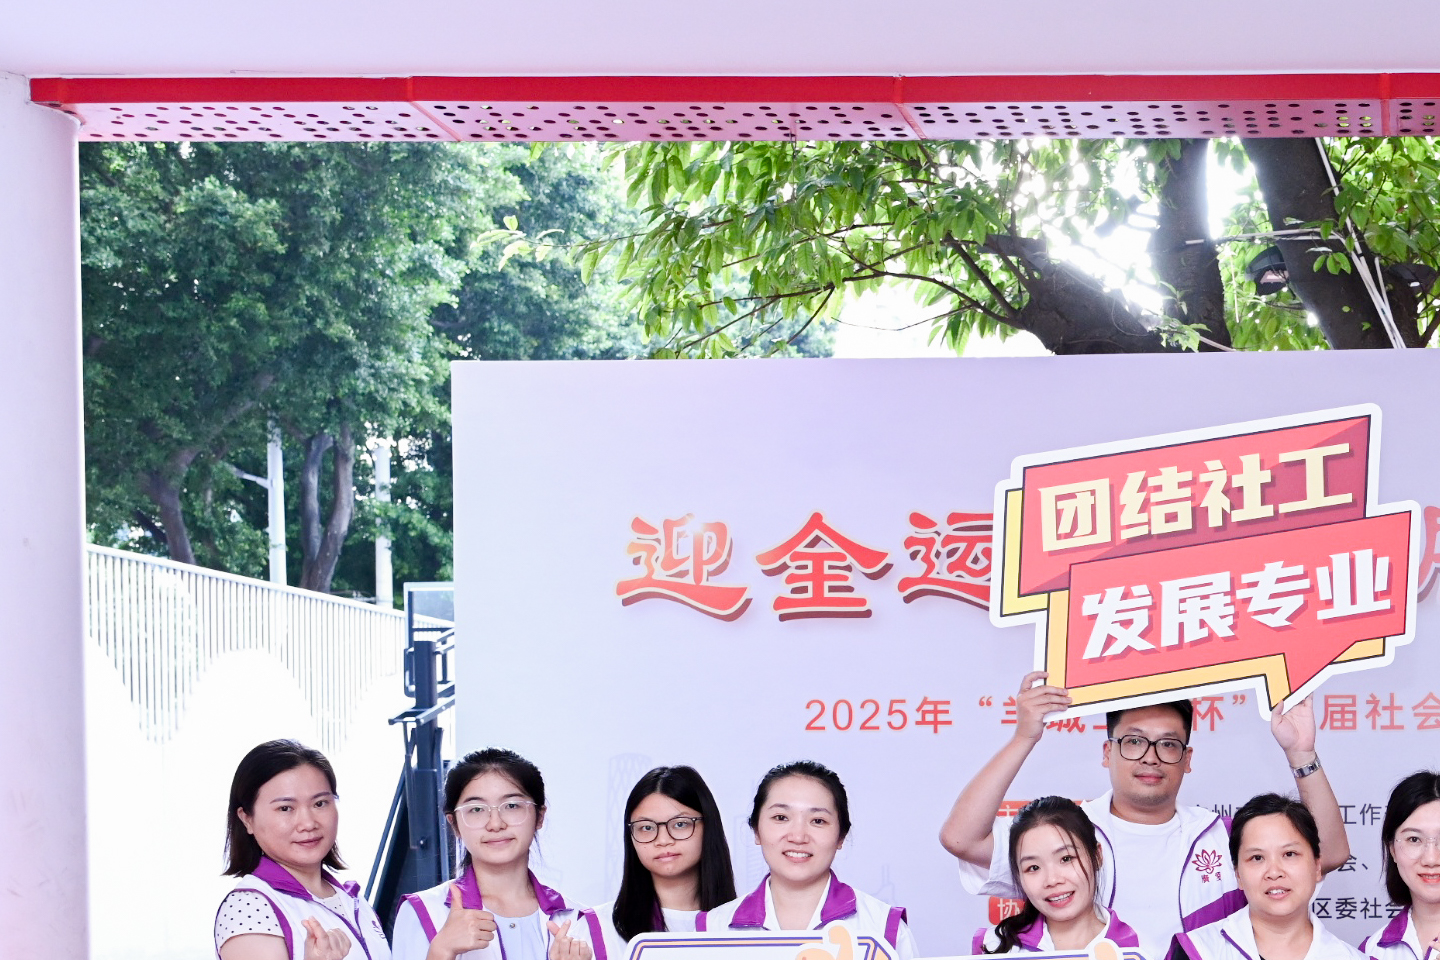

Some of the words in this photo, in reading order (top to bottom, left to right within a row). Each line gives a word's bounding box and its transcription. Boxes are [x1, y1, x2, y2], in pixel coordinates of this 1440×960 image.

[1038, 442, 1354, 551] 团结社工
[1082, 548, 1391, 660] 发展专业
